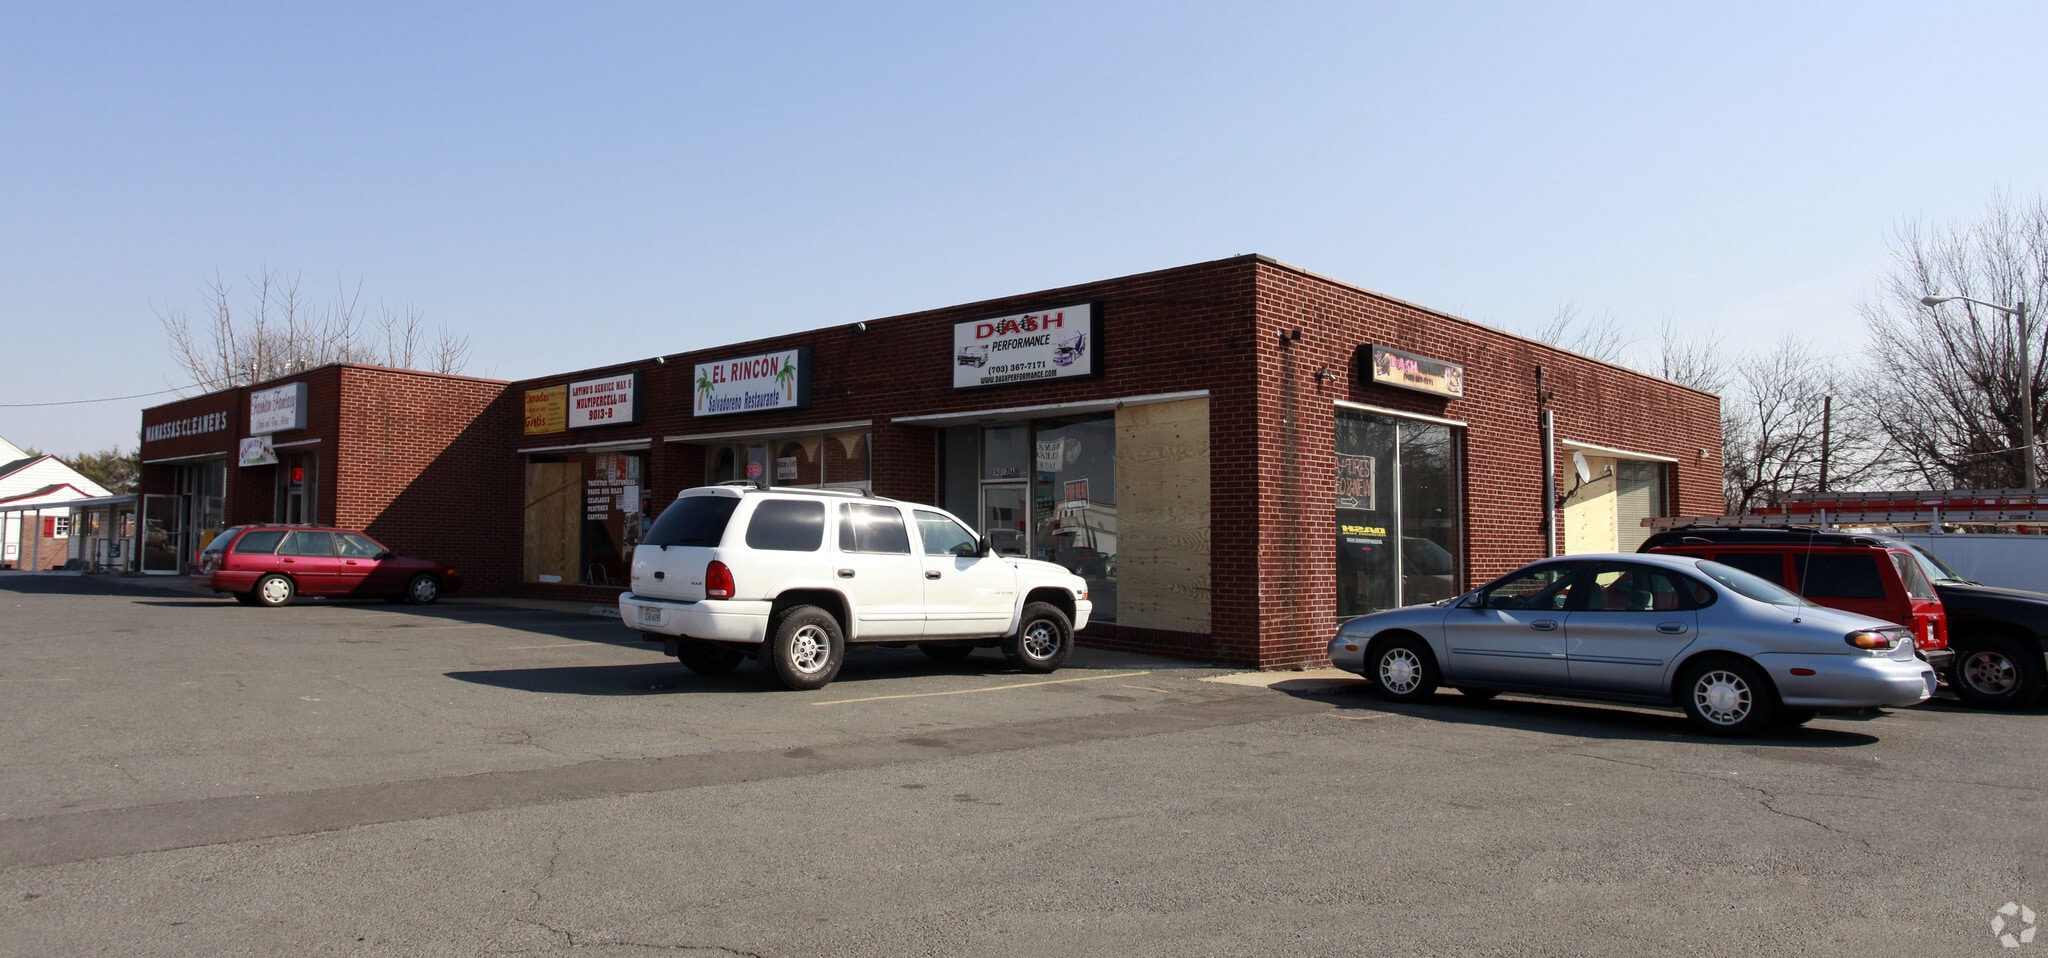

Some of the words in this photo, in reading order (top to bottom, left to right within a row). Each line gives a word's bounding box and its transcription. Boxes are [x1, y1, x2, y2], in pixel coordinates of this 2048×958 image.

[975, 311, 1065, 339] DASH
[991, 334, 1050, 352] PERFORMANCE
[712, 365, 726, 384] EL
[731, 354, 779, 382] RINCÓN
[988, 365, 1008, 375] (703)
[1010, 361, 1046, 371] 367-7171
[1390, 355, 1418, 374] DASH
[980, 369, 1057, 385] WWW.DASHPERFORMANCE.COM
[572, 385, 593, 397] LATINO'S
[594, 382, 614, 393] SERVICE
[744, 389, 779, 409] Restaurante
[525, 414, 546, 427] Gratis
[588, 408, 613, 421] 9013-B
[146, 420, 181, 442] MANASSAS
[182, 411, 227, 436] CLEANERS
